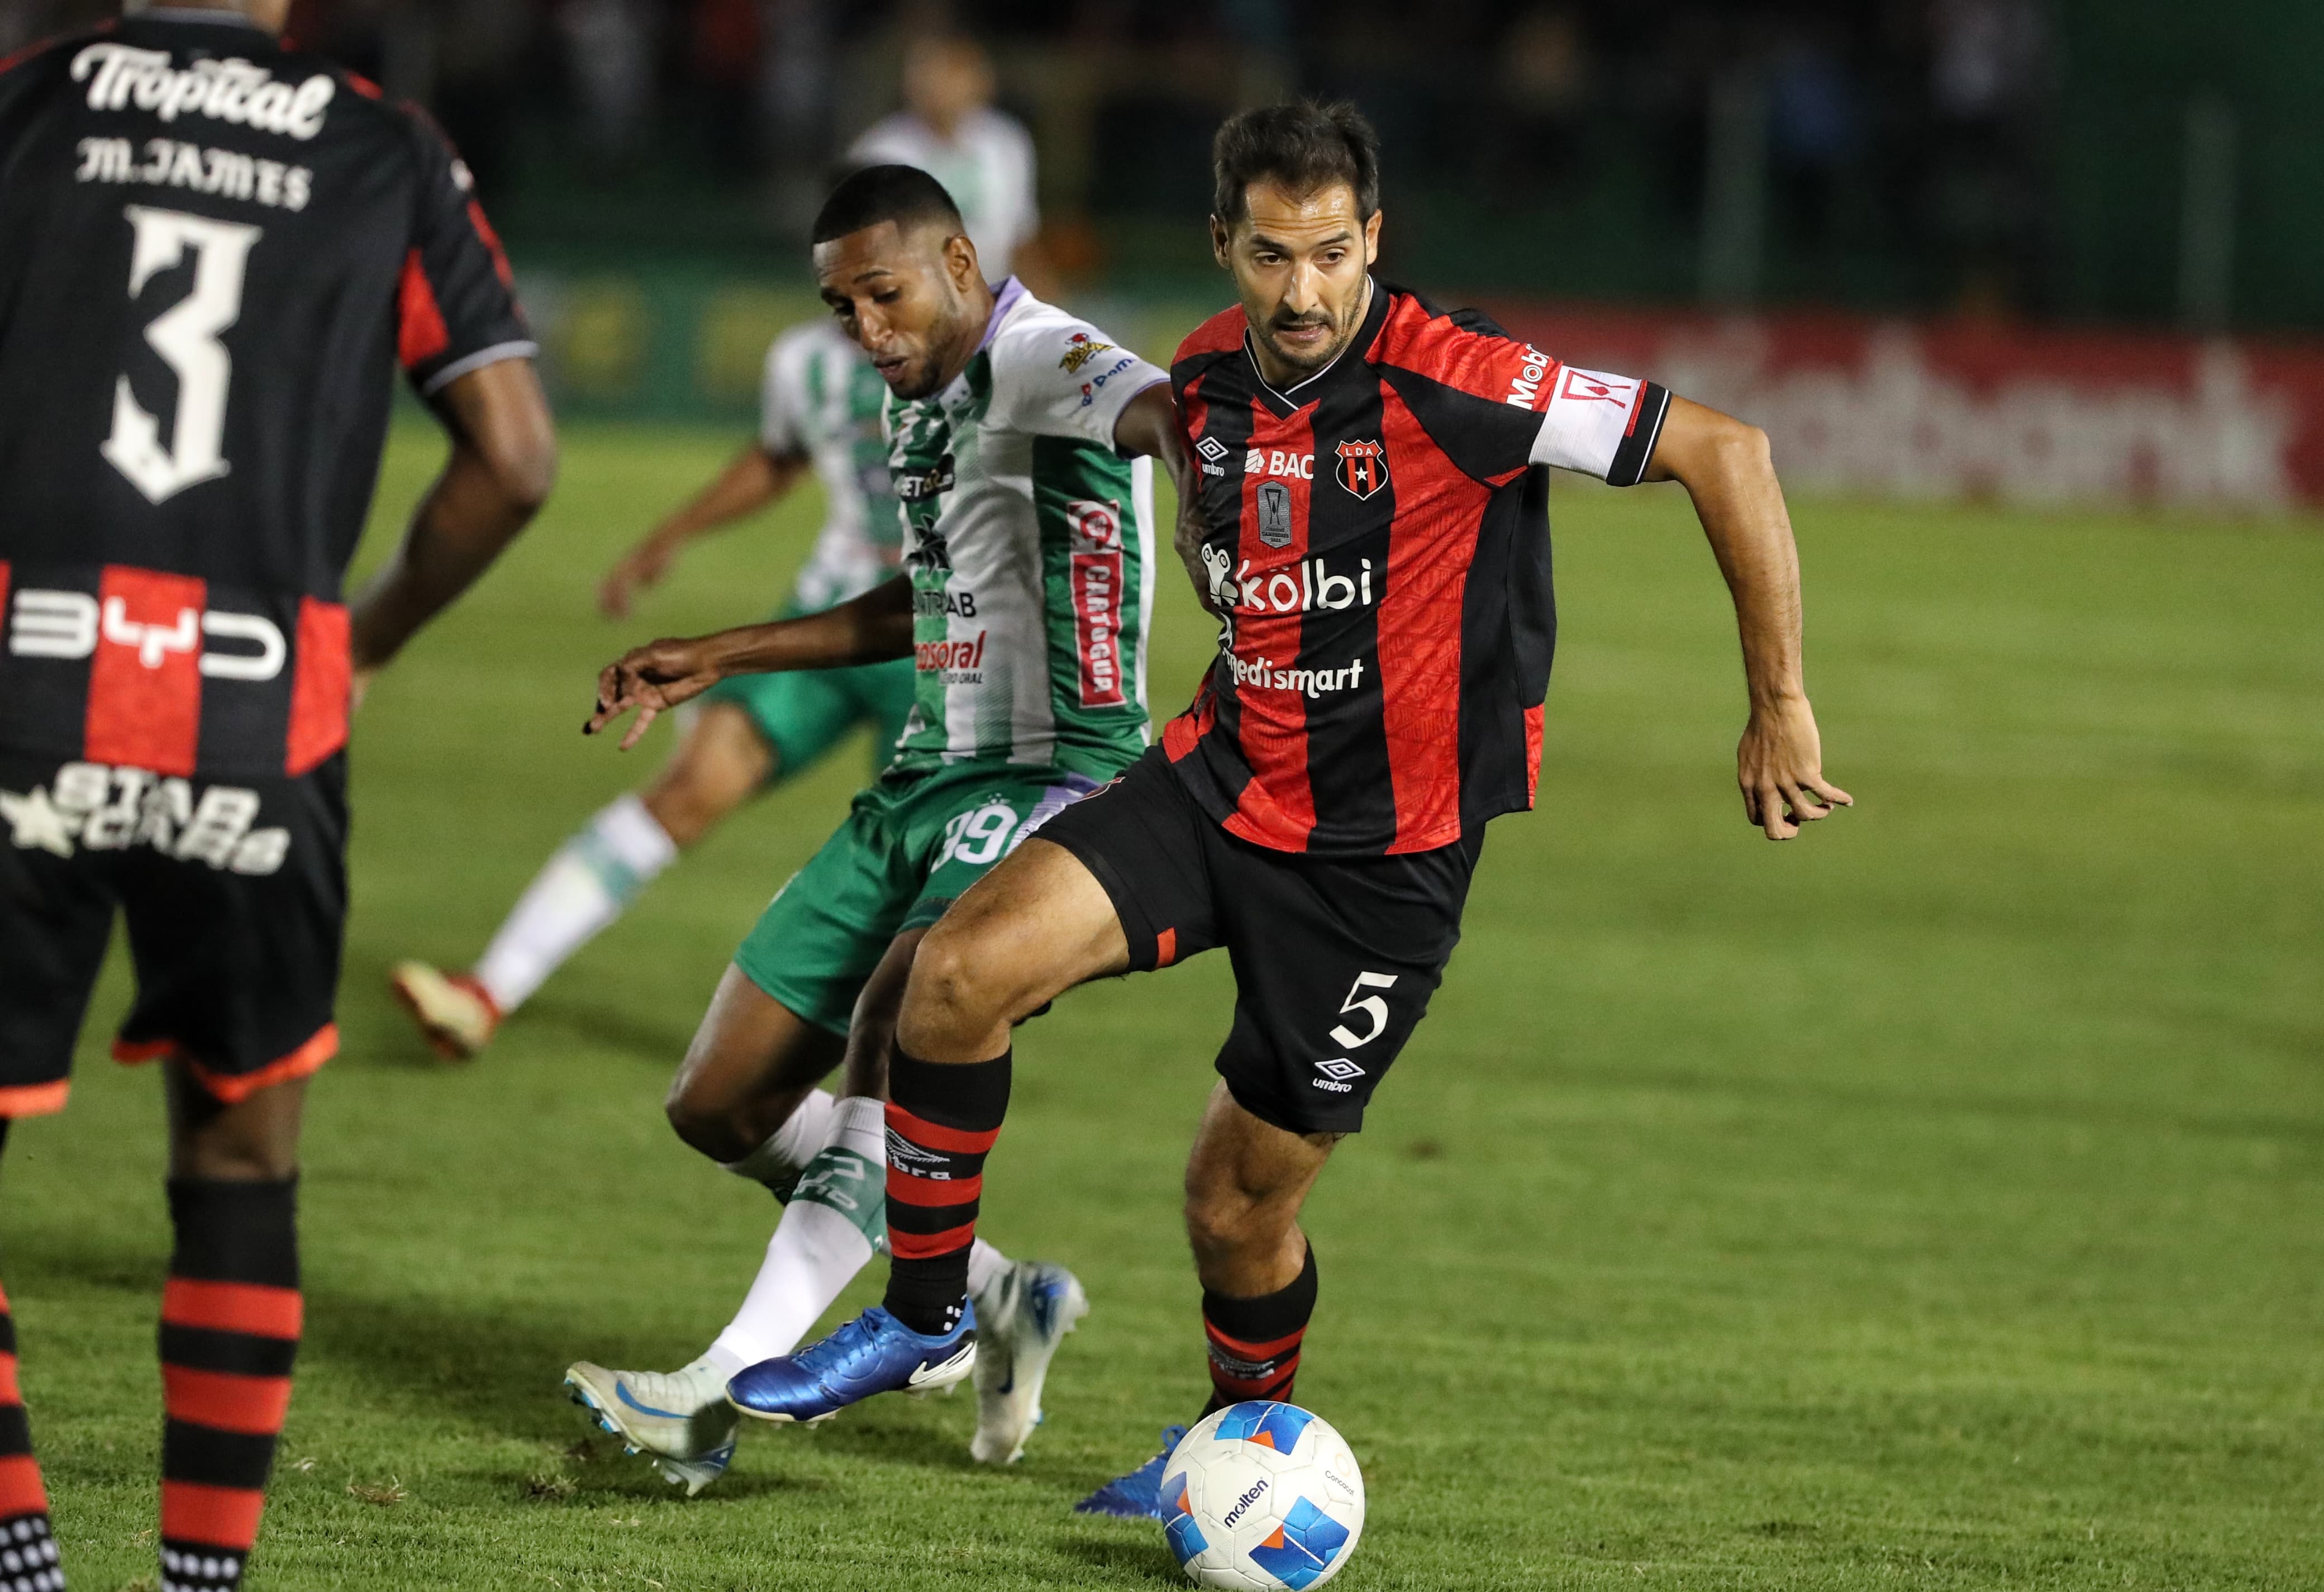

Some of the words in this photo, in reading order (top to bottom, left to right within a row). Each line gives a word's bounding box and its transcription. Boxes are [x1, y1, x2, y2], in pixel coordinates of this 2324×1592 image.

[70, 42, 335, 140] Tropical
[76, 136, 313, 211] M.JAMES
[101, 204, 263, 504] 3
[1202, 462, 1225, 477] umbro
[1268, 451, 1315, 479] BAC
[1345, 447, 1374, 457] LDA
[1236, 559, 1371, 612] kölbi
[9, 588, 286, 681] BYD
[1084, 565, 1114, 693] CARTOGUA
[1328, 971, 1398, 1049] 5
[1312, 1077, 1353, 1093] umbro
[1224, 1479, 1269, 1528] molten
[1325, 1470, 1355, 1496] Concacaf
